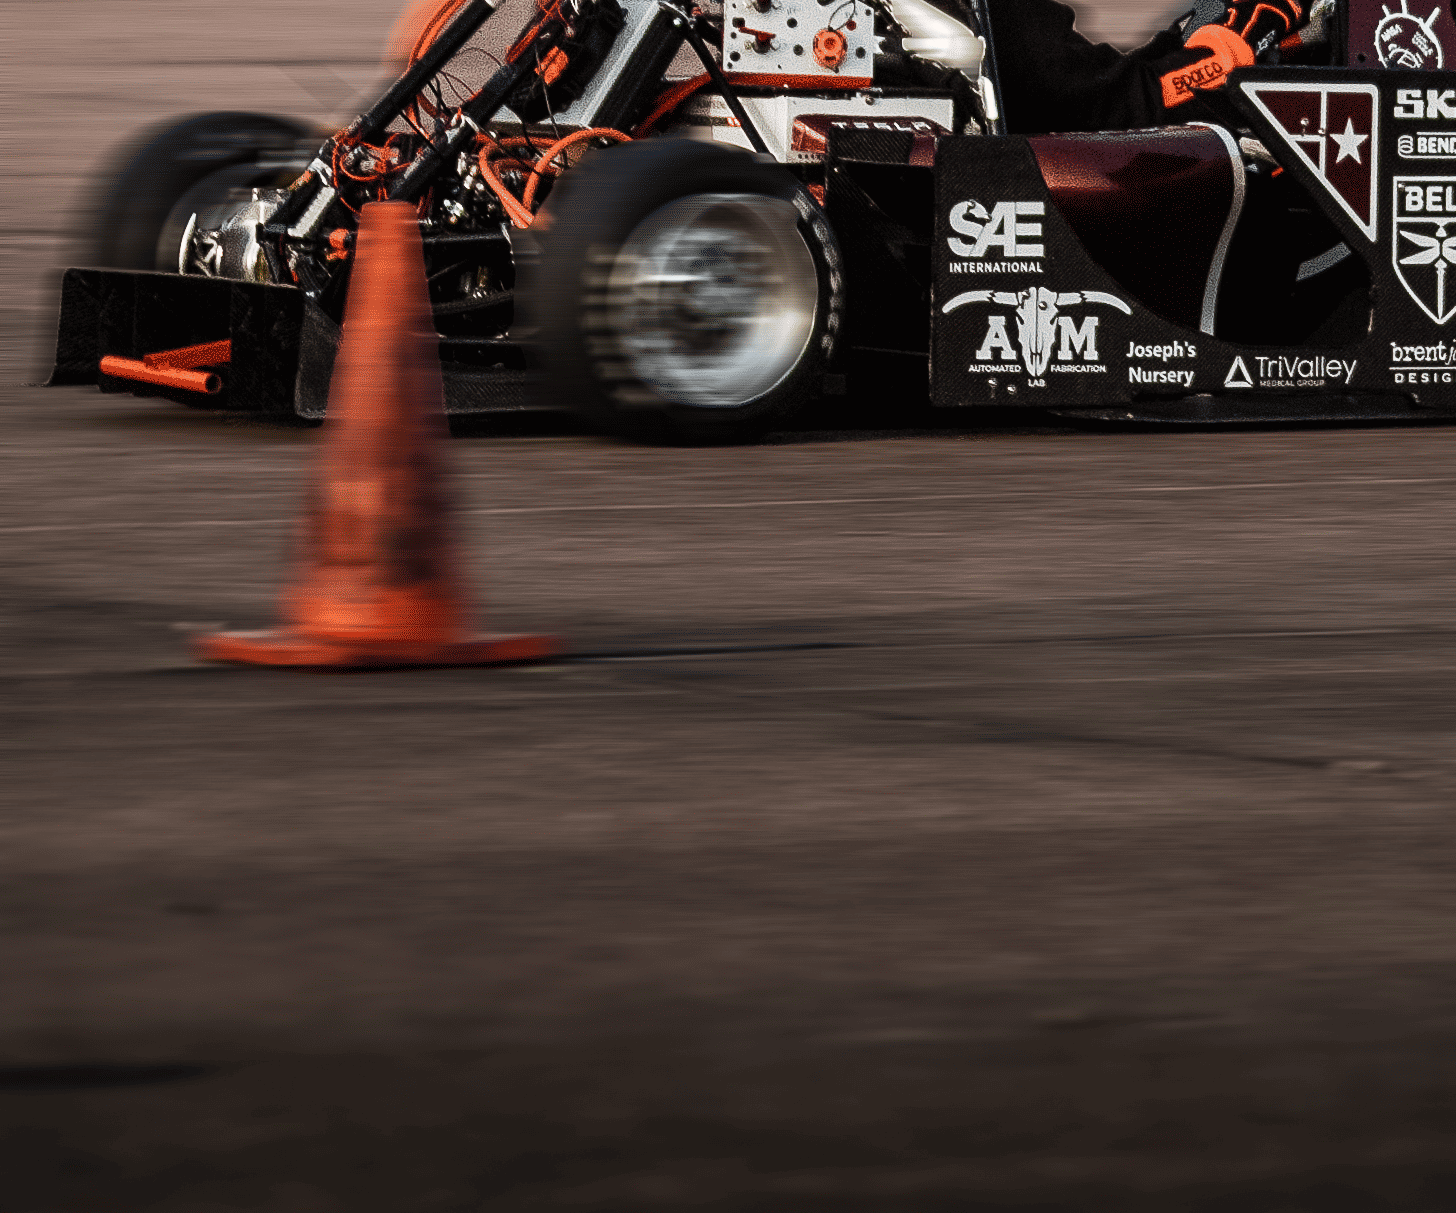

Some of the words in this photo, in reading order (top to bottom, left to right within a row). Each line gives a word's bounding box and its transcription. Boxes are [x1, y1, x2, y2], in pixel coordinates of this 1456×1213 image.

[947, 199, 1046, 258] SAE
[949, 261, 1044, 274] INTERNATIONAL
[1126, 340, 1197, 362] Joseph's
[1390, 340, 1447, 362] brent
[968, 364, 1022, 373] AUTOMATED
[1050, 364, 1107, 373] FABRICATION
[1128, 366, 1195, 388] Nursery
[1254, 355, 1358, 385] TriValley
[1027, 378, 1046, 387] LAB
